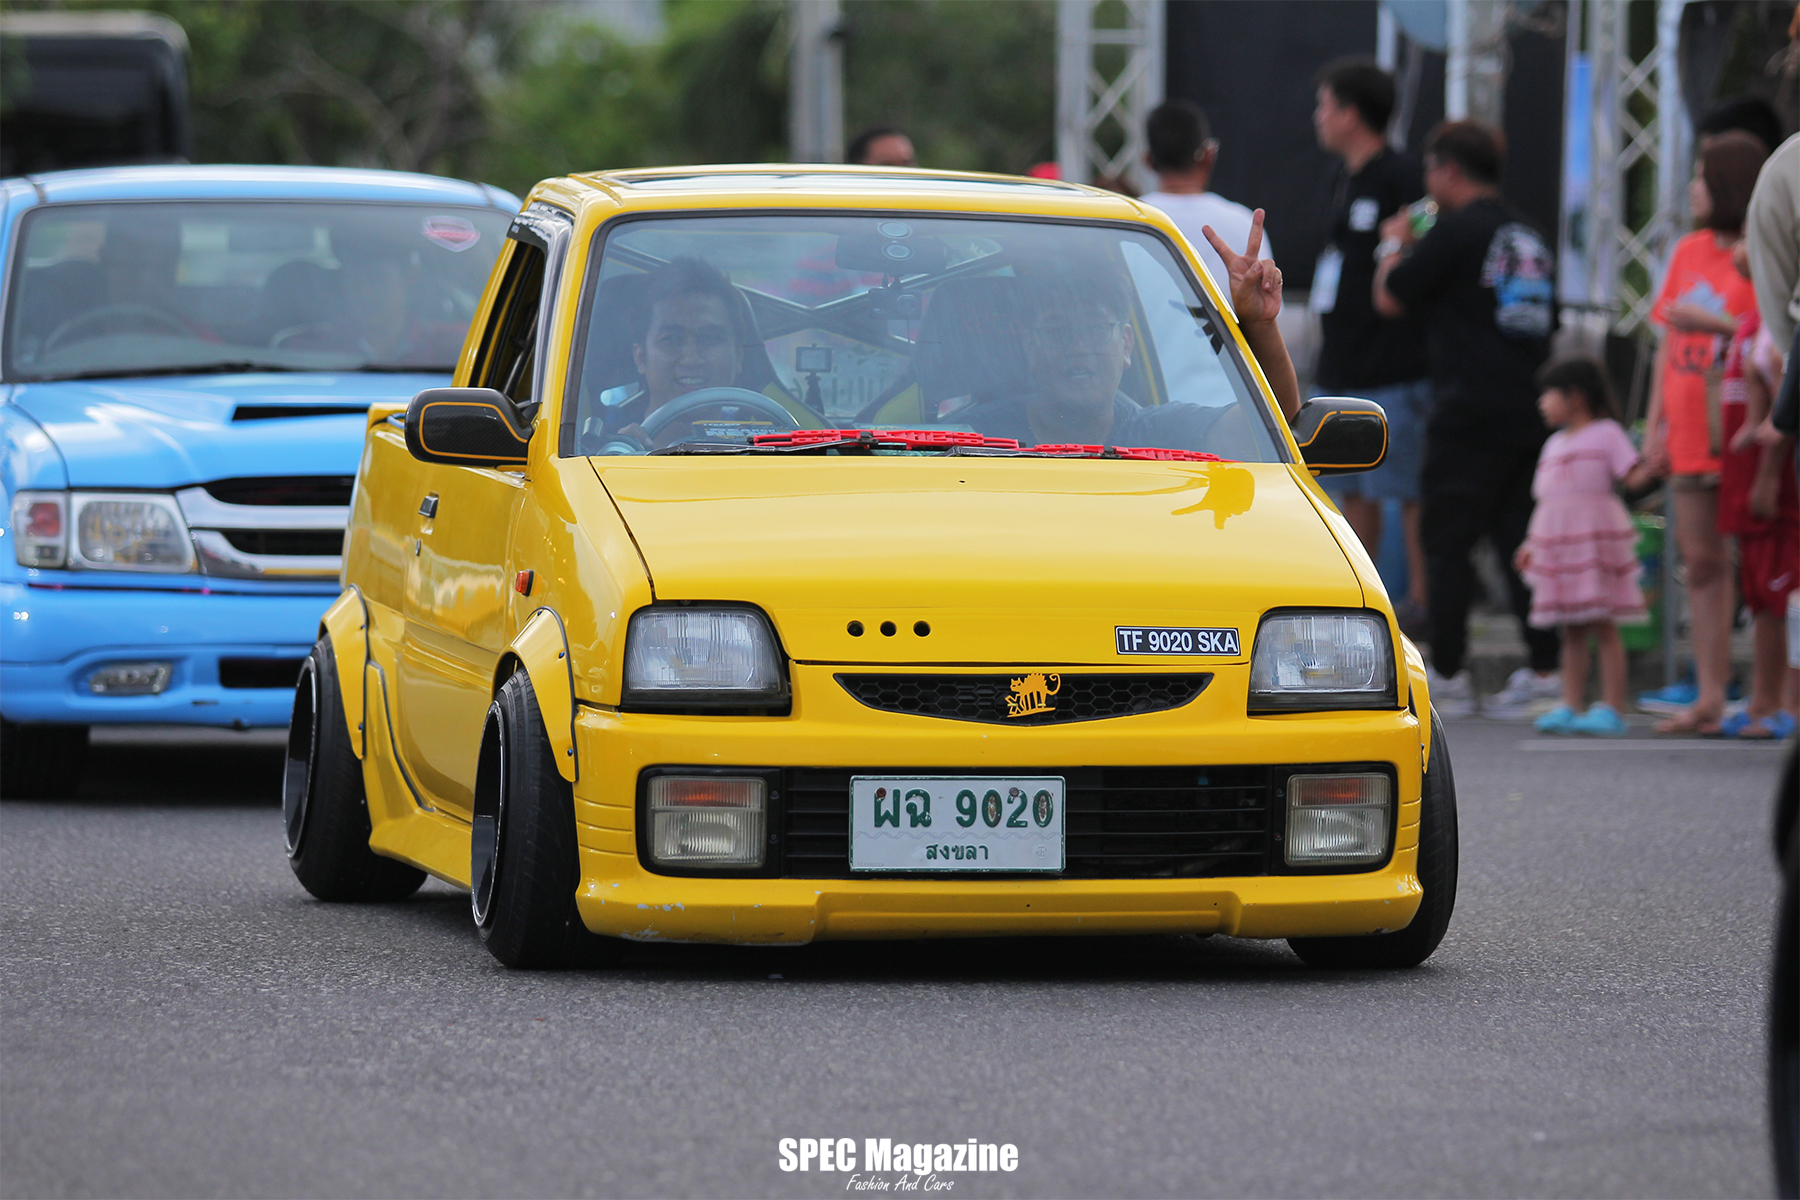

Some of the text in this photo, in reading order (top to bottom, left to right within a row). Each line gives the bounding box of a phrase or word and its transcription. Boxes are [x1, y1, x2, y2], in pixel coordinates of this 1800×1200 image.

[1119, 630, 1238, 652] TF 9020 SKA
[874, 788, 1054, 828] ผฉ 9020
[926, 844, 989, 860] สงขลา
